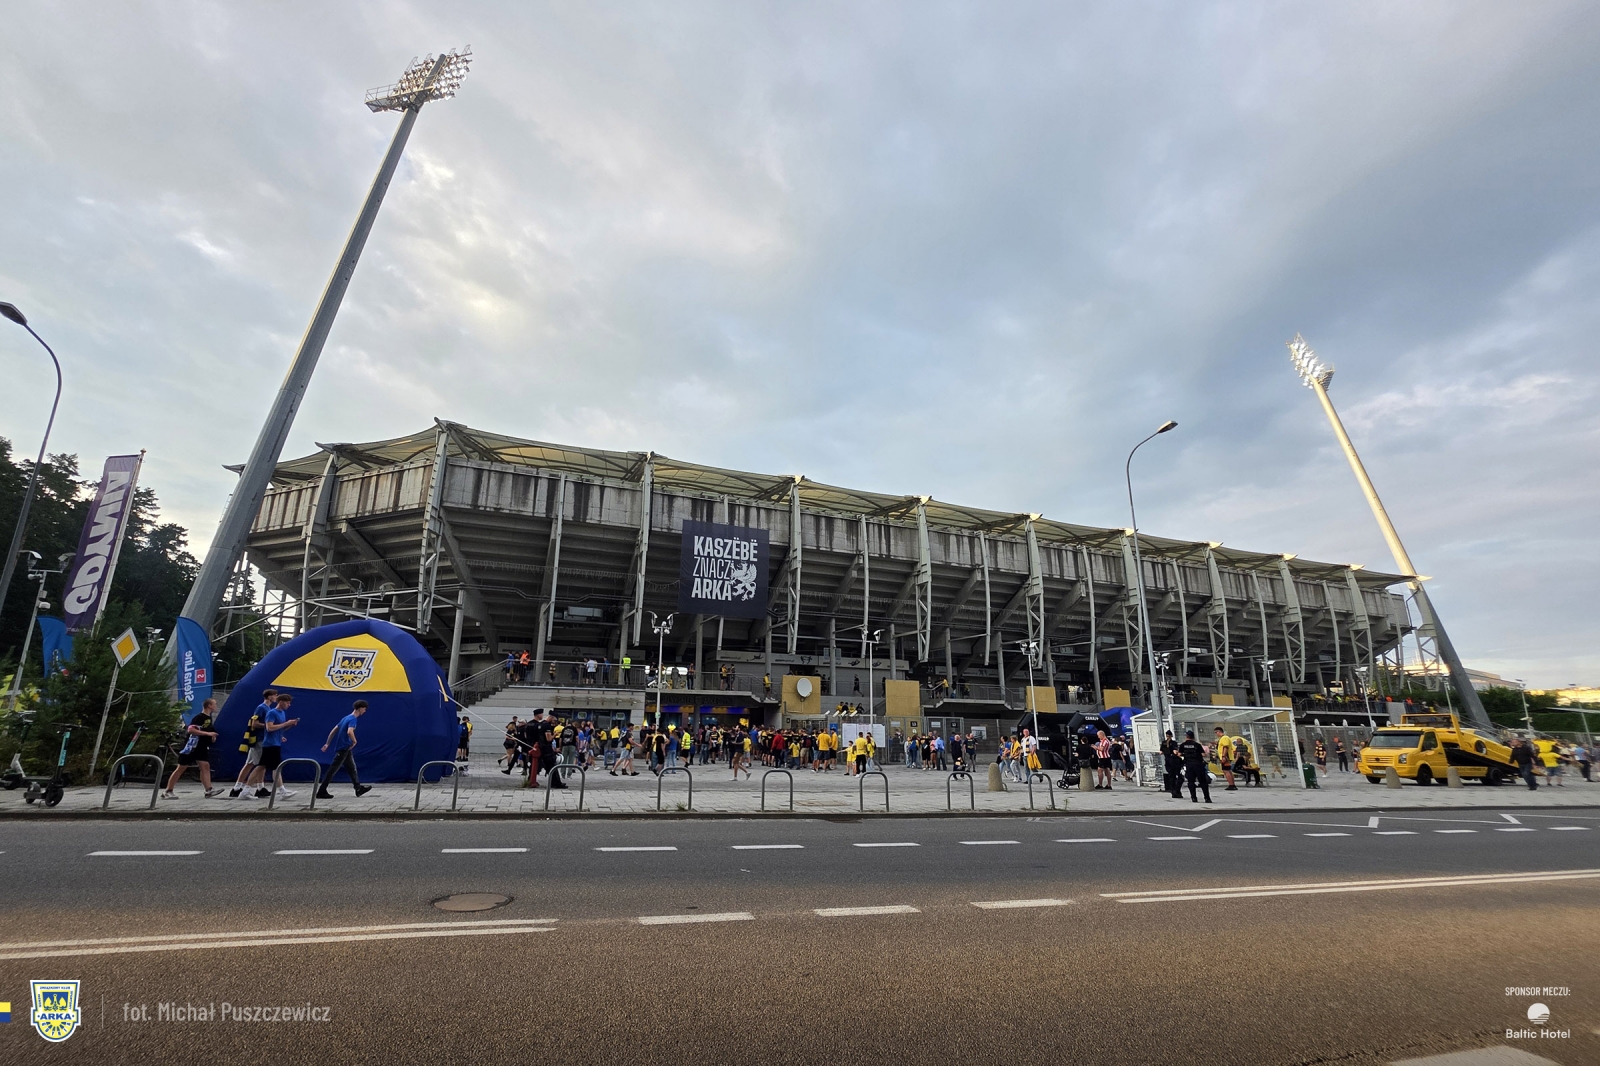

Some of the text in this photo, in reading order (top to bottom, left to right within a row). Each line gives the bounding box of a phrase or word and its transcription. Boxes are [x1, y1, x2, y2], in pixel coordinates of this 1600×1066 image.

[693, 535, 758, 562] KASZËBË
[692, 556, 731, 580] ZNACZ
[691, 578, 732, 601] ARKA
